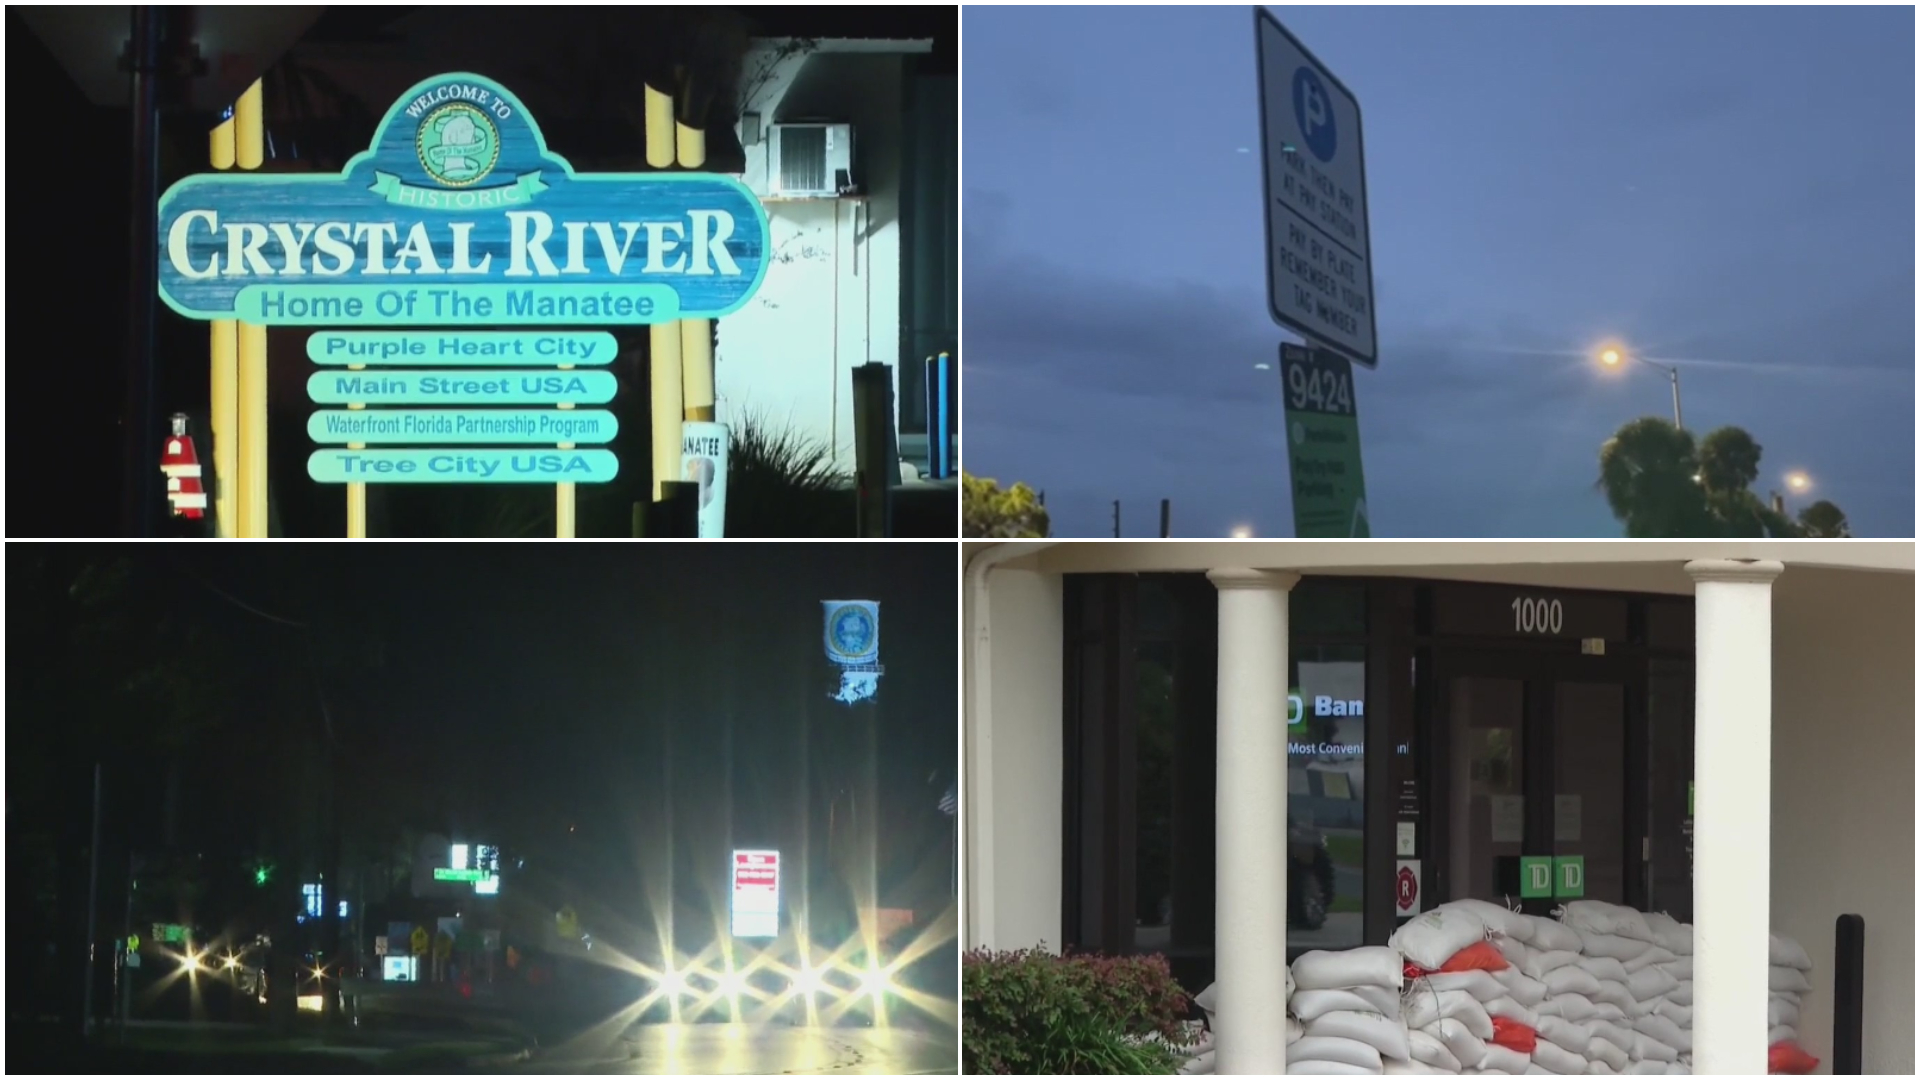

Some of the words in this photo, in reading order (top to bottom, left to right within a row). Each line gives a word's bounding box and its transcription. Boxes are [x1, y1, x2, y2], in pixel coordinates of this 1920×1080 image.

[404, 83, 490, 119] WELCOME
[490, 96, 512, 120] TO
[1280, 141, 1306, 179] PARK
[1310, 164, 1335, 202] THEN
[1339, 187, 1355, 217] PAY
[400, 186, 520, 208] HISTORIC
[1284, 171, 1295, 198] AT
[1299, 183, 1317, 214] PAY
[1320, 200, 1357, 241] STATION
[167, 208, 492, 277] CRYSTAL
[504, 208, 742, 277] RIVER
[1289, 222, 1306, 252] PAY
[1311, 238, 1324, 266] BY
[1327, 249, 1356, 285] PLATE
[1280, 245, 1337, 300] REMEMBER
[1341, 285, 1367, 317] YOUR
[260, 290, 364, 318] Home
[375, 289, 417, 317] Of
[426, 289, 494, 317] The
[505, 290, 655, 317] Manatee
[1294, 283, 1313, 316] TAG
[1316, 299, 1358, 338] NUMBER
[325, 338, 427, 360] Purple
[438, 338, 523, 356] Heart
[534, 337, 598, 360] City
[335, 377, 408, 395] Main
[418, 376, 511, 395] Street
[521, 377, 588, 395] USA
[1289, 363, 1351, 413] 9424
[326, 415, 401, 434] Waterfront
[404, 414, 453, 434] Florida
[456, 414, 536, 438] Partnership
[540, 415, 600, 437] Program
[681, 436, 720, 457] ANATEE
[336, 455, 418, 473] Tree
[428, 454, 501, 477] City
[511, 455, 593, 473] USA
[1511, 596, 1563, 634] 1000
[1314, 694, 1364, 717] Ban
[1288, 742, 1316, 755] Most
[1318, 742, 1364, 755] Conveni
[1401, 879, 1410, 897] R
[1528, 863, 1550, 889] TD
[1561, 862, 1581, 888] TD
